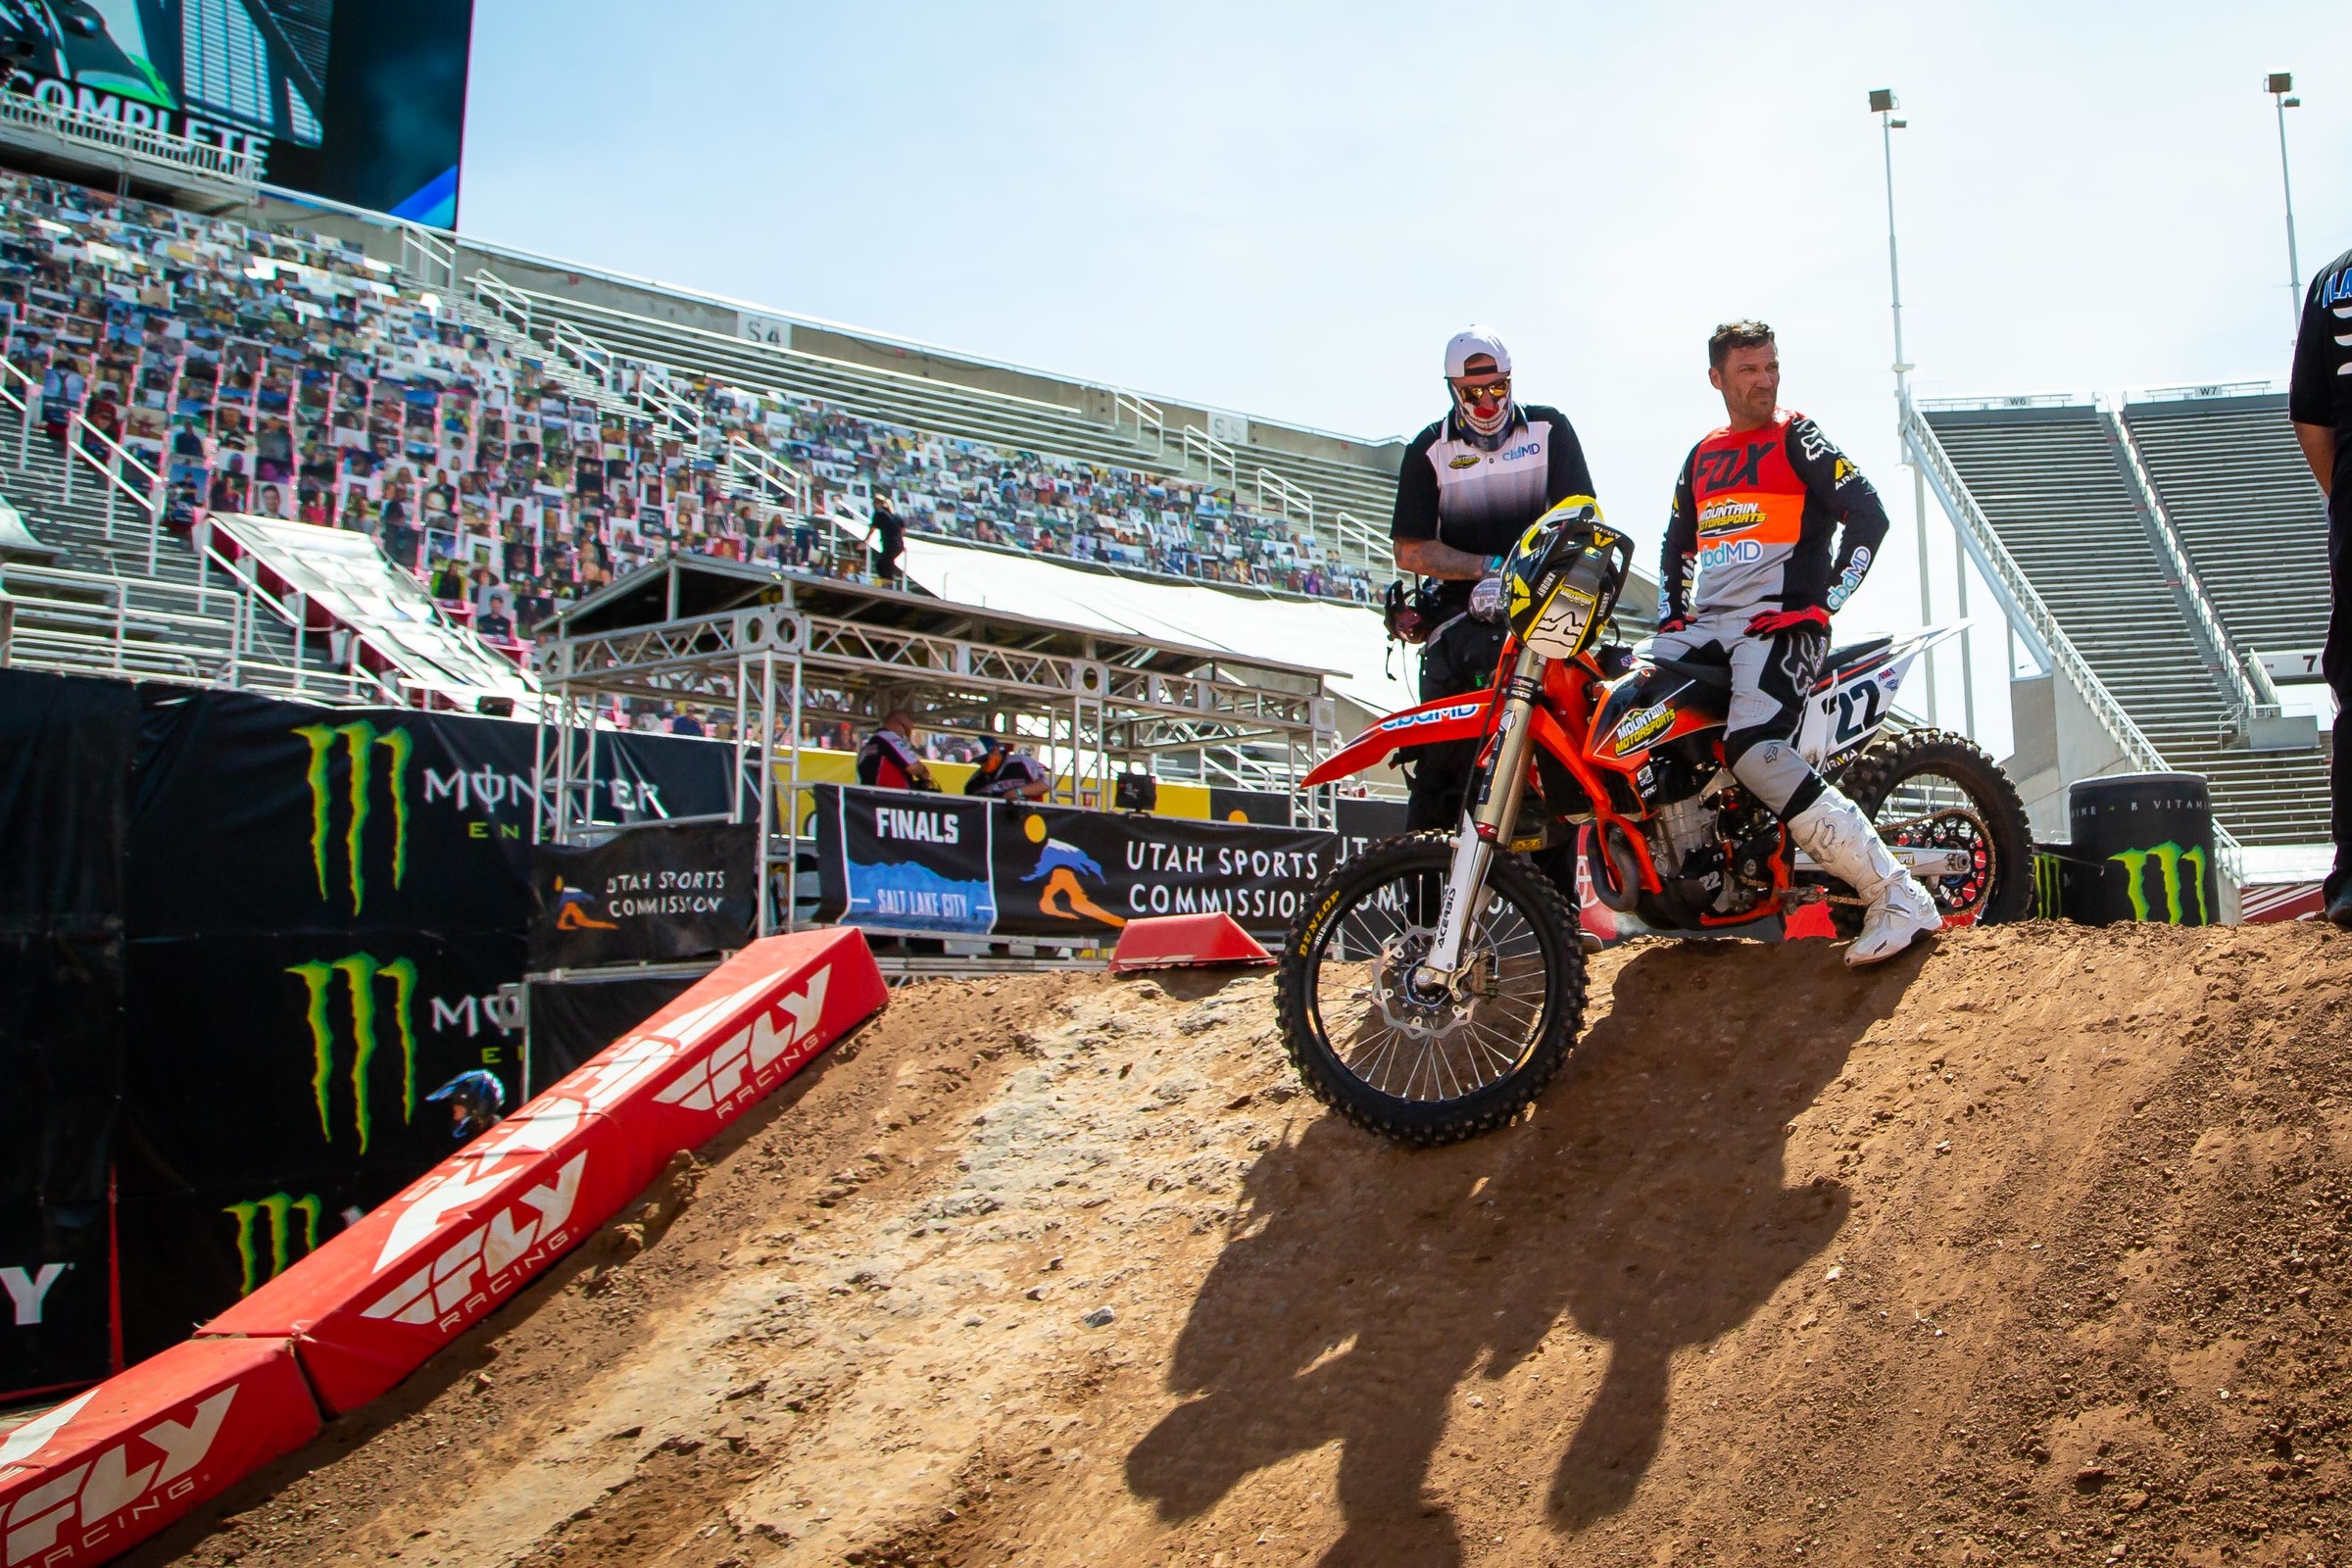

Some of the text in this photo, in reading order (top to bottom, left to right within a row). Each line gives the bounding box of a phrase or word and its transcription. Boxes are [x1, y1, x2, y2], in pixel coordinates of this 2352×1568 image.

[1695, 441, 1778, 493] FOX
[1827, 548, 1871, 610] cbdMD
[2303, 655, 2317, 672] 7
[875, 808, 959, 844] FINALS
[1127, 841, 1204, 874] UTAH
[1218, 848, 1318, 880] SPORTS
[877, 889, 967, 918] SALT LAKE CITY
[1299, 890, 1340, 956] DUNLOP
[716, 1034, 818, 1120] RACING
[438, 1234, 568, 1332] RACING
